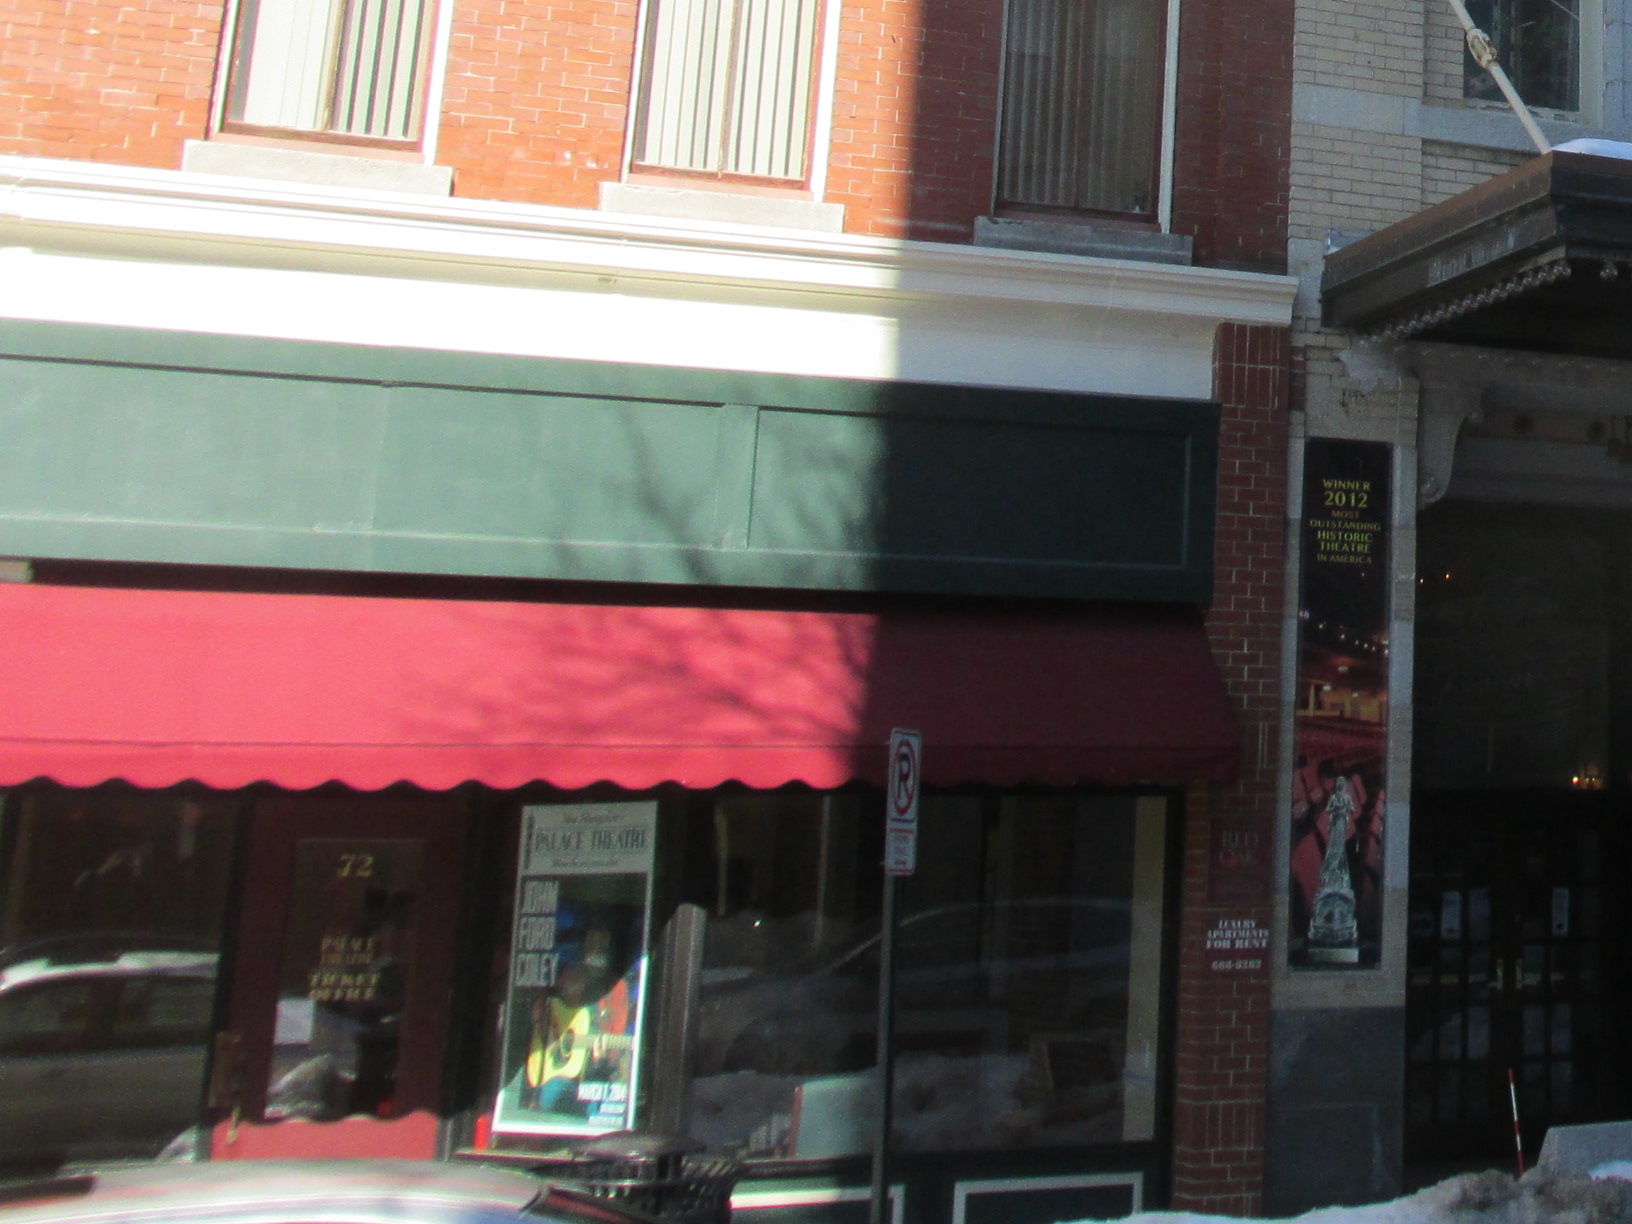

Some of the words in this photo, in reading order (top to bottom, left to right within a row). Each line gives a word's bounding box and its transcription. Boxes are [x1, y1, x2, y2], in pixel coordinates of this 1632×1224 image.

[1322, 478, 1371, 491] WINNER
[1323, 490, 1369, 508] 2012
[1309, 519, 1382, 531] OUTSTANDING
[1316, 530, 1373, 543] HISTORIC
[1319, 541, 1371, 554] THEATRE
[1329, 554, 1373, 564] AMERICA
[535, 831, 583, 851] PALACE
[590, 828, 647, 851] THEATRE
[337, 853, 375, 878] 72
[1218, 919, 1257, 929] LUXURY
[1207, 928, 1269, 939] APARTMENTS
[1206, 938, 1232, 950] FOR
[1234, 938, 1267, 950] RENT
